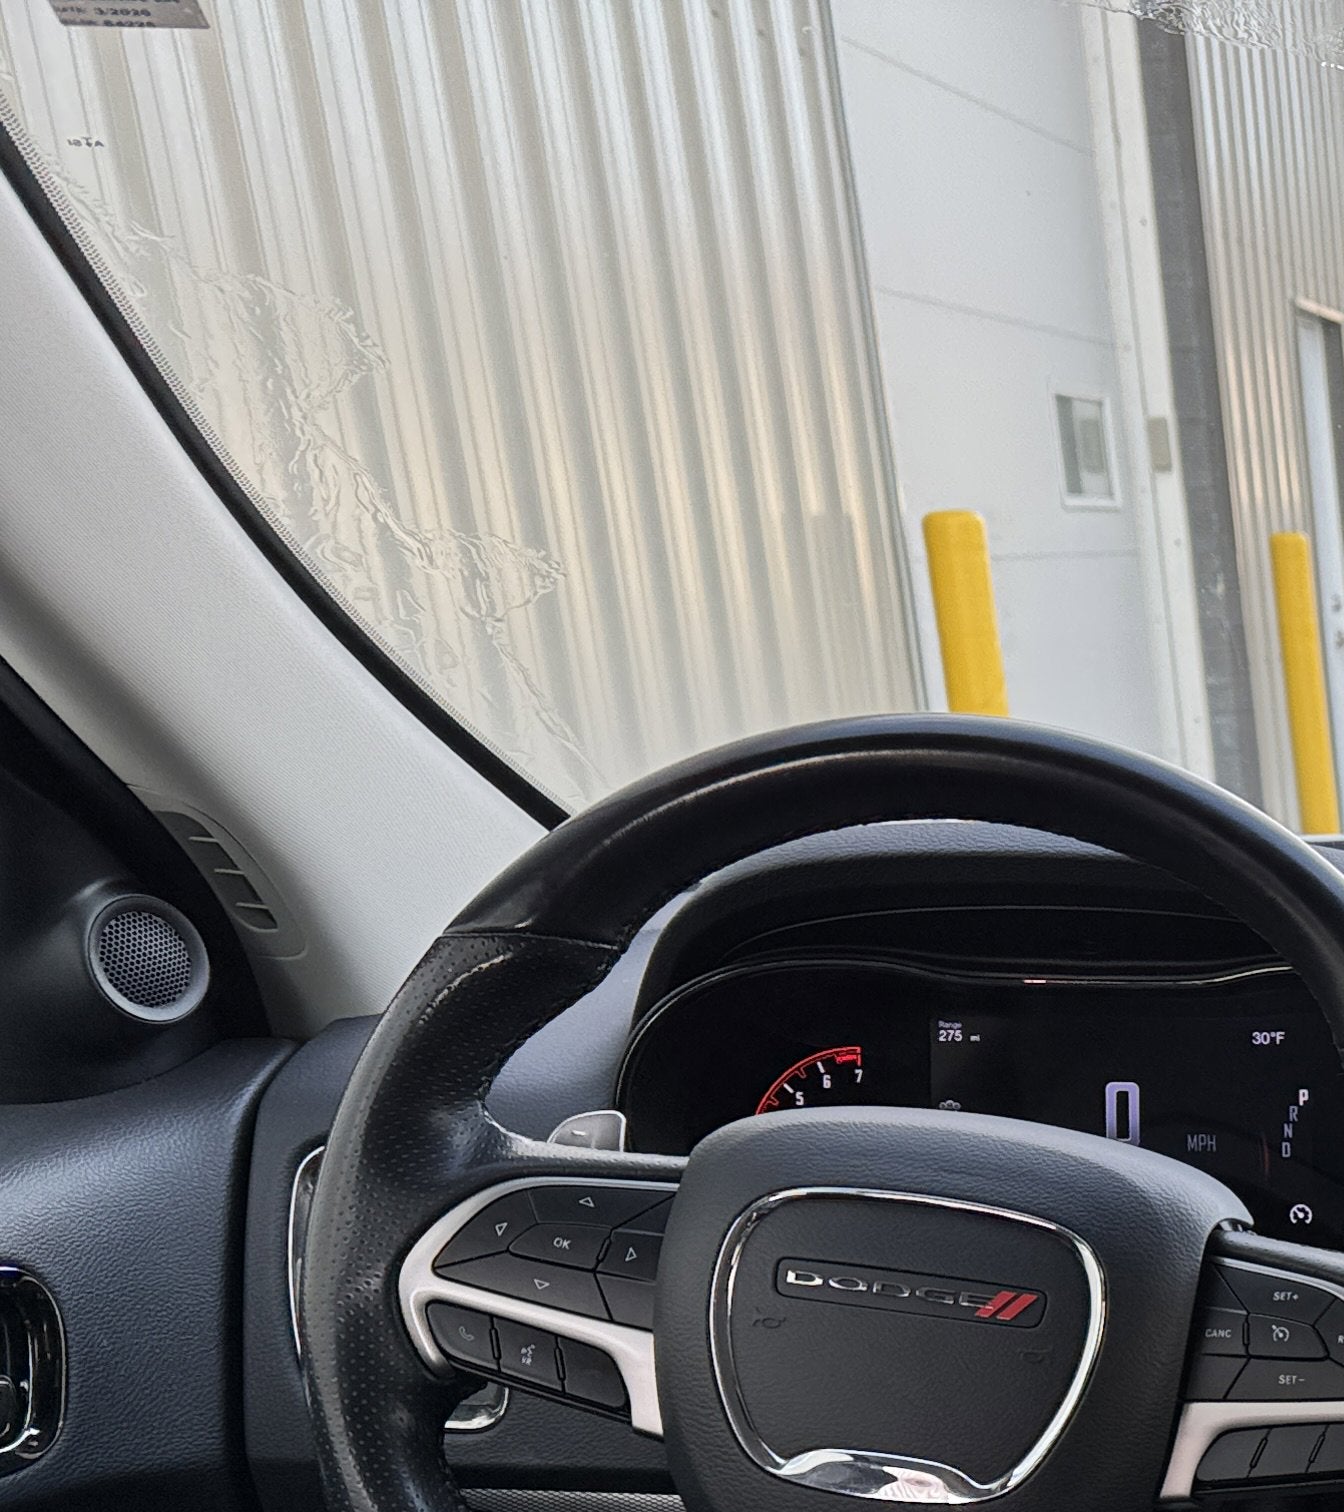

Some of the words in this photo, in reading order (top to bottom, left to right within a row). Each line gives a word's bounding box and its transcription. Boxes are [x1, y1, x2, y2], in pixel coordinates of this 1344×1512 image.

[938, 1020, 963, 1030] Range
[938, 1030, 963, 1042] 275
[1252, 1032, 1286, 1045] 30°F
[822, 1074, 832, 1089] 6
[854, 1069, 863, 1083] 7
[795, 1091, 805, 1106] 5
[1299, 1088, 1309, 1106] P
[1105, 1081, 1141, 1146] 0
[1289, 1105, 1299, 1122] R
[1284, 1123, 1293, 1139] N
[1186, 1134, 1217, 1152] MPH
[1281, 1141, 1291, 1158] D
[553, 1236, 571, 1250] OK
[786, 1269, 994, 1311] DODGE
[1205, 1328, 1232, 1339] CANC
